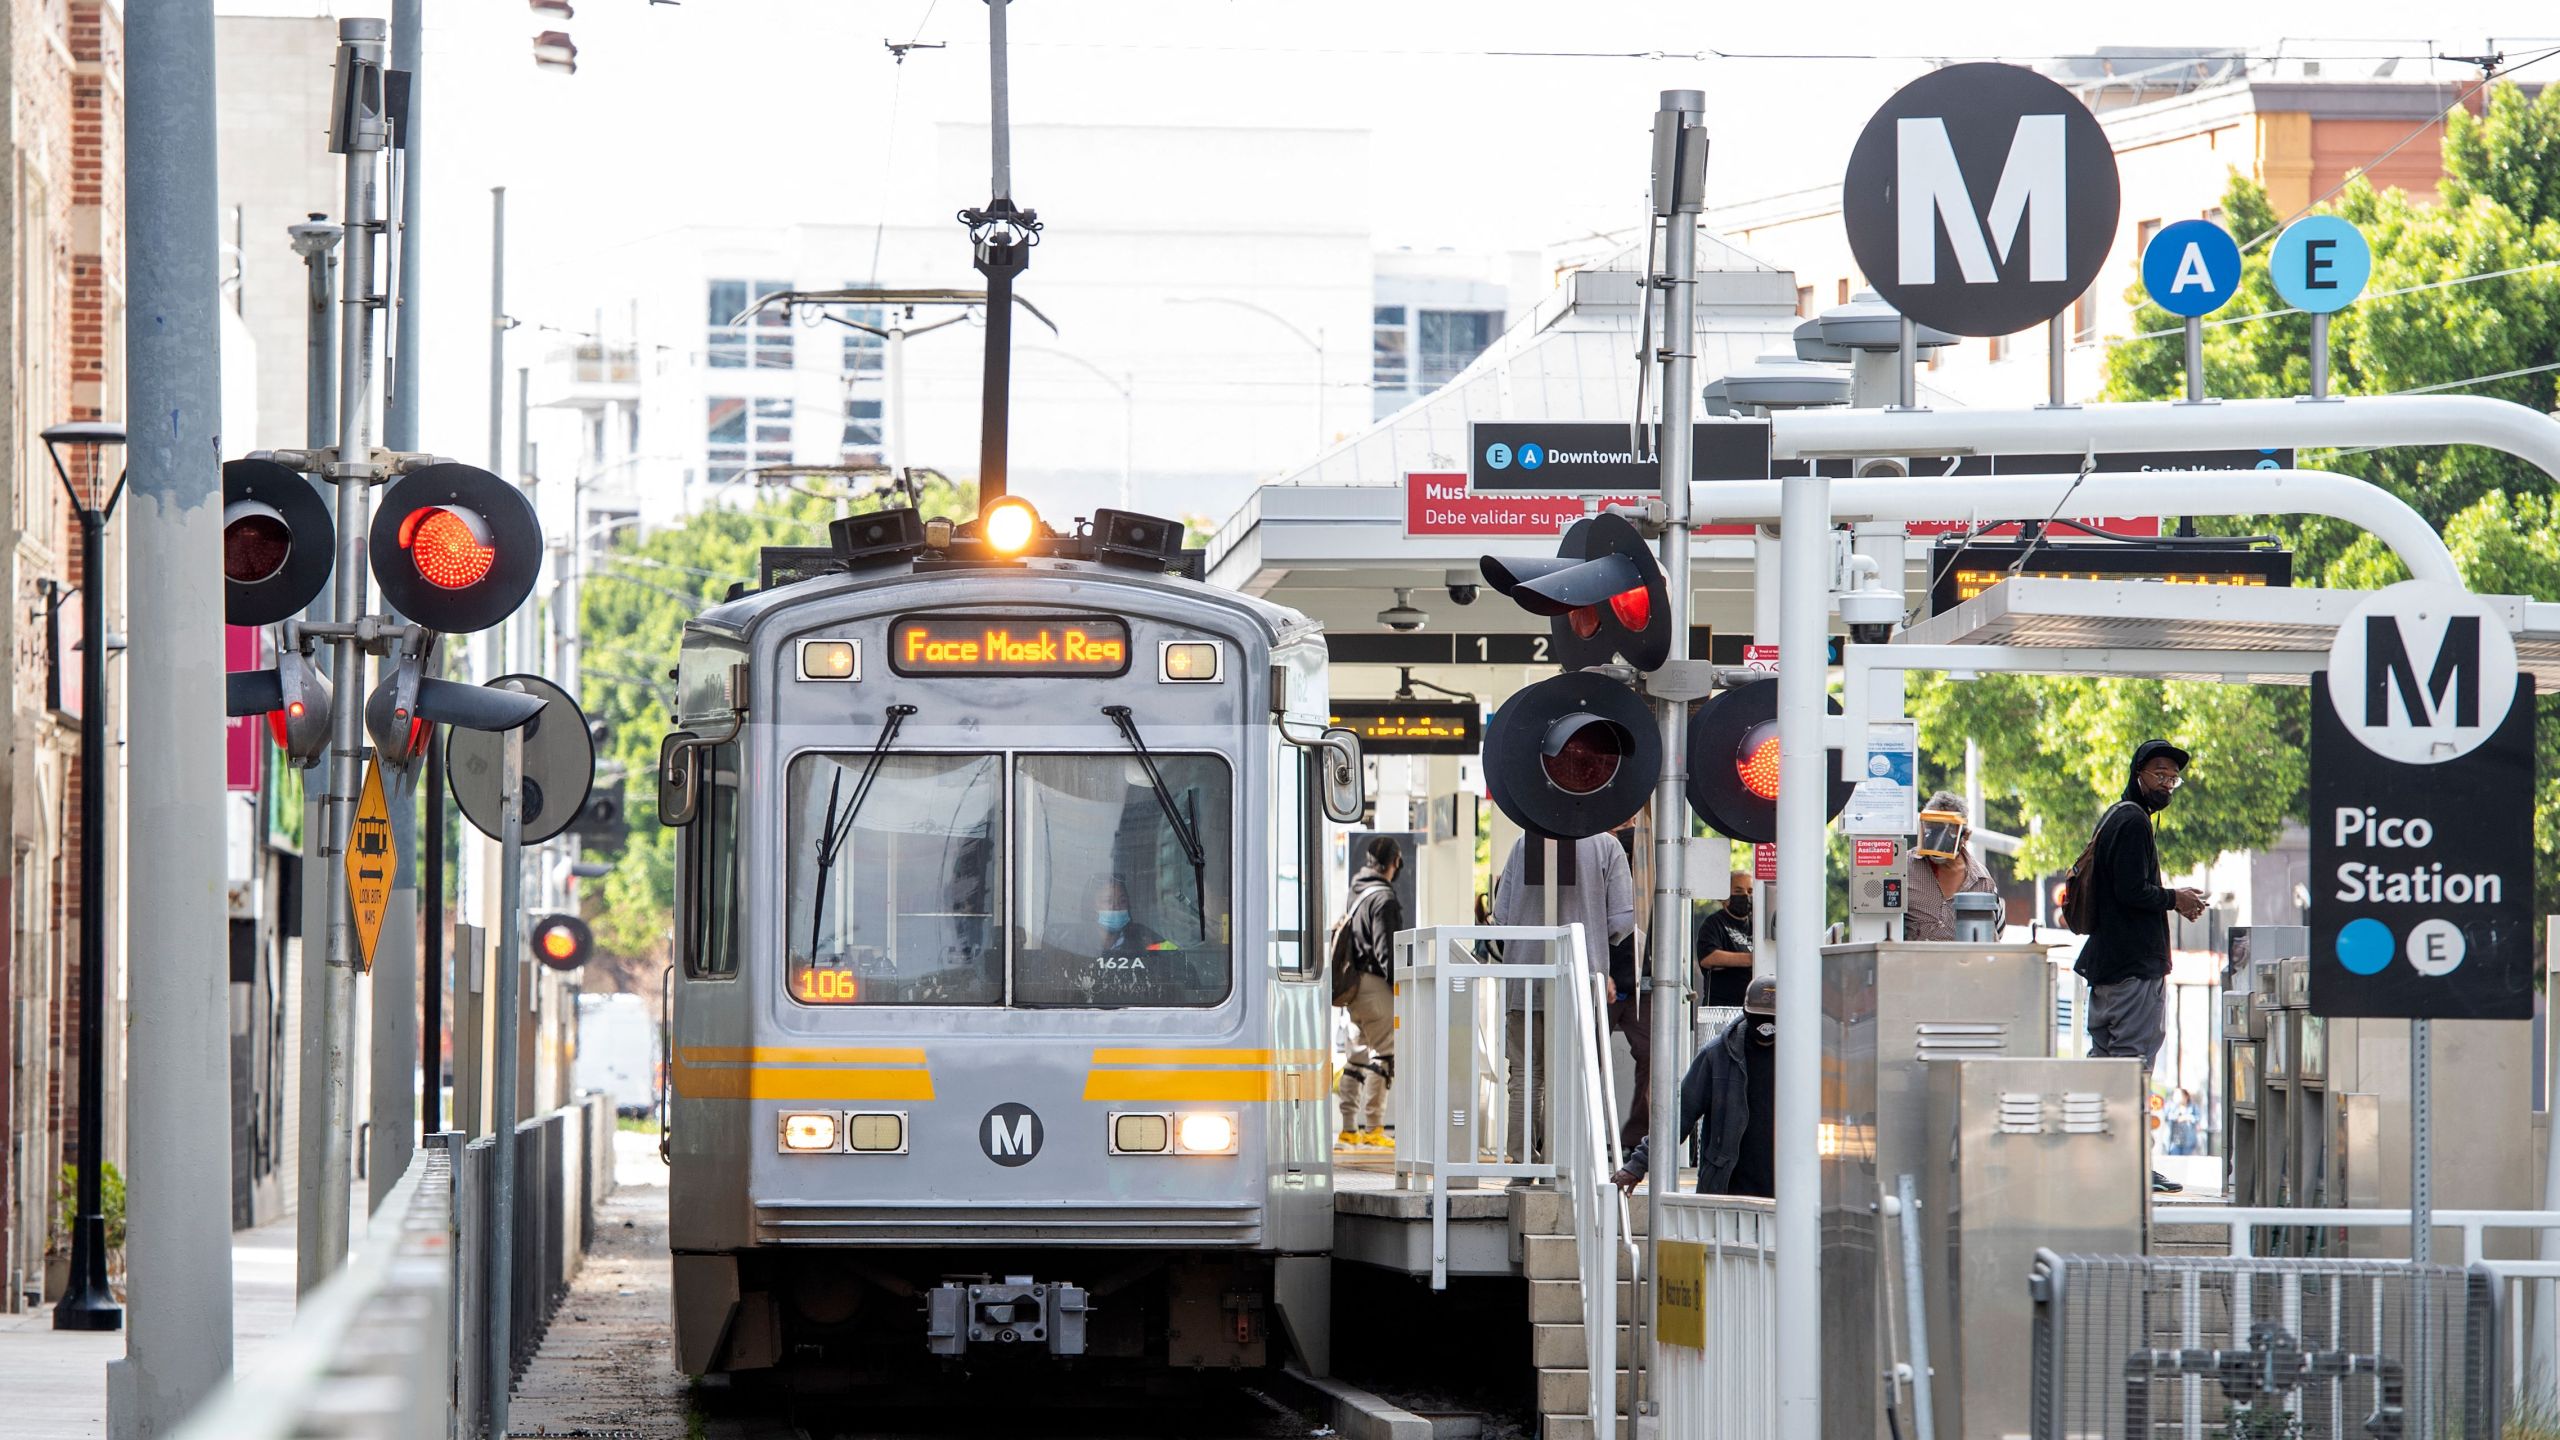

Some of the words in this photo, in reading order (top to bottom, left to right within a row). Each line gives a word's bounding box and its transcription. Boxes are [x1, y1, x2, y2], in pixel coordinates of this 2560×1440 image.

[1897, 114, 2067, 285] M
[2170, 241, 2216, 294] A
[2306, 239, 2338, 290] E
[1494, 449, 1504, 464] E
[1524, 449, 1537, 464] A
[1548, 449, 1632, 465] Downtown
[1637, 449, 1659, 465] LA
[1425, 509, 1467, 525] Debe
[1470, 509, 1527, 525] validar
[1531, 513, 1550, 525] su
[908, 630, 979, 661] Face
[987, 630, 1057, 661] Mask
[1065, 630, 1121, 661] Req
[1476, 636, 1489, 662] 1
[1532, 636, 1550, 662] 2
[2365, 615, 2481, 728] M
[2335, 805, 2434, 849] Pico
[1857, 840, 1892, 848] Emergency
[2335, 861, 2502, 904] Station
[2426, 932, 2447, 962] E
[1096, 956, 1146, 970] 162A
[802, 970, 855, 998] 106
[991, 1114, 1033, 1156] M
